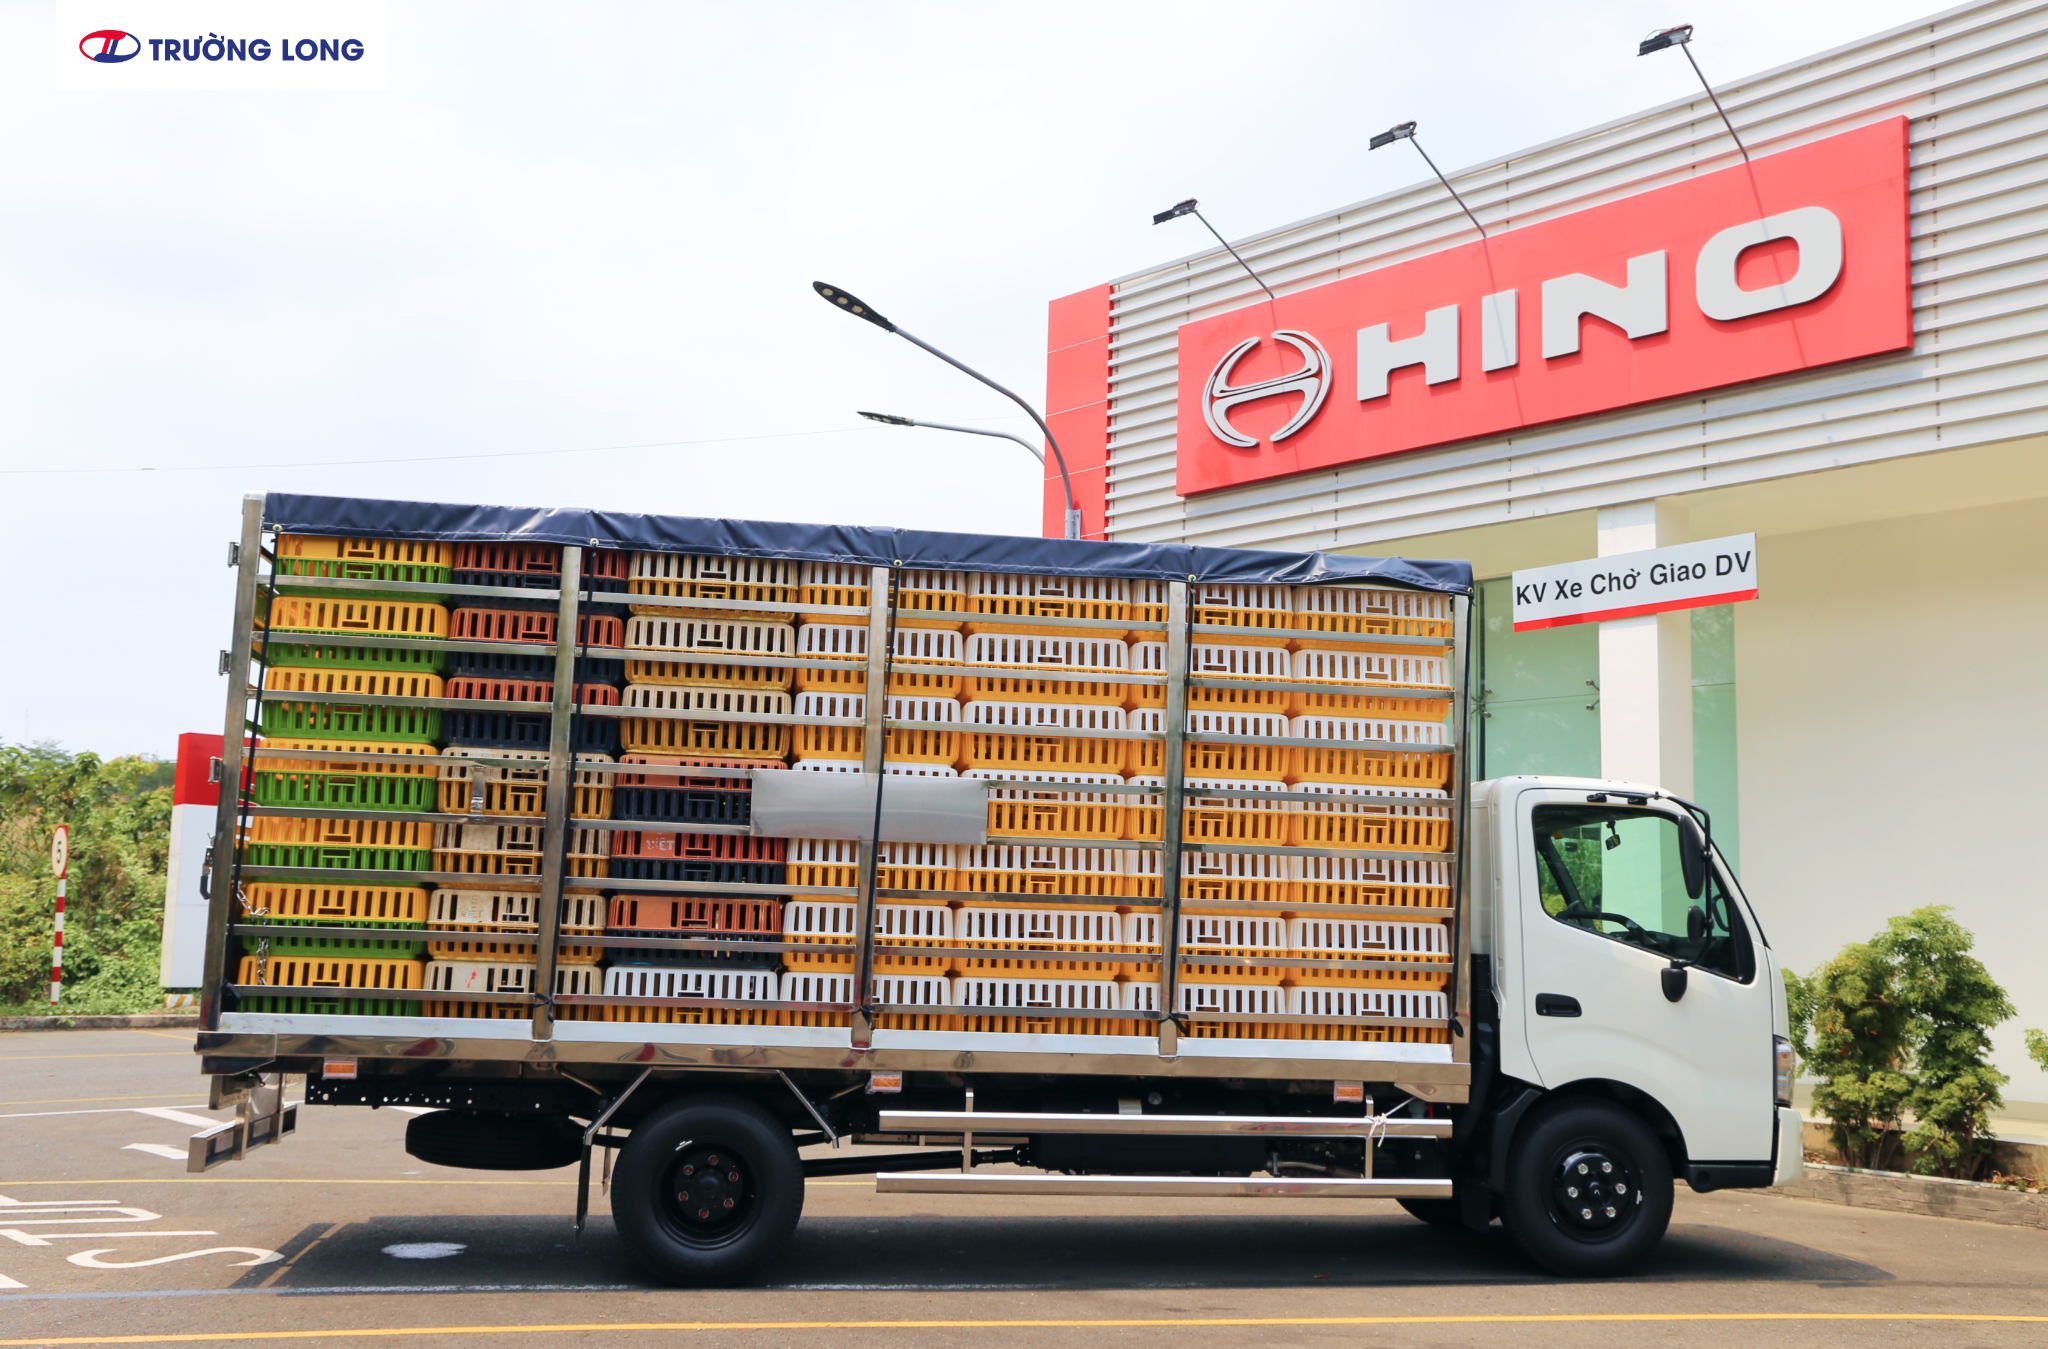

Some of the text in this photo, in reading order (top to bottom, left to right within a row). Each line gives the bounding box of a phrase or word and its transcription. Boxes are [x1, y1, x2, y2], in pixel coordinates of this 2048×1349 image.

[1356, 205, 1844, 402] HINO
[1516, 550, 1751, 606] KV Xe Chờ Giao DV
[56, 840, 62, 864] 5
